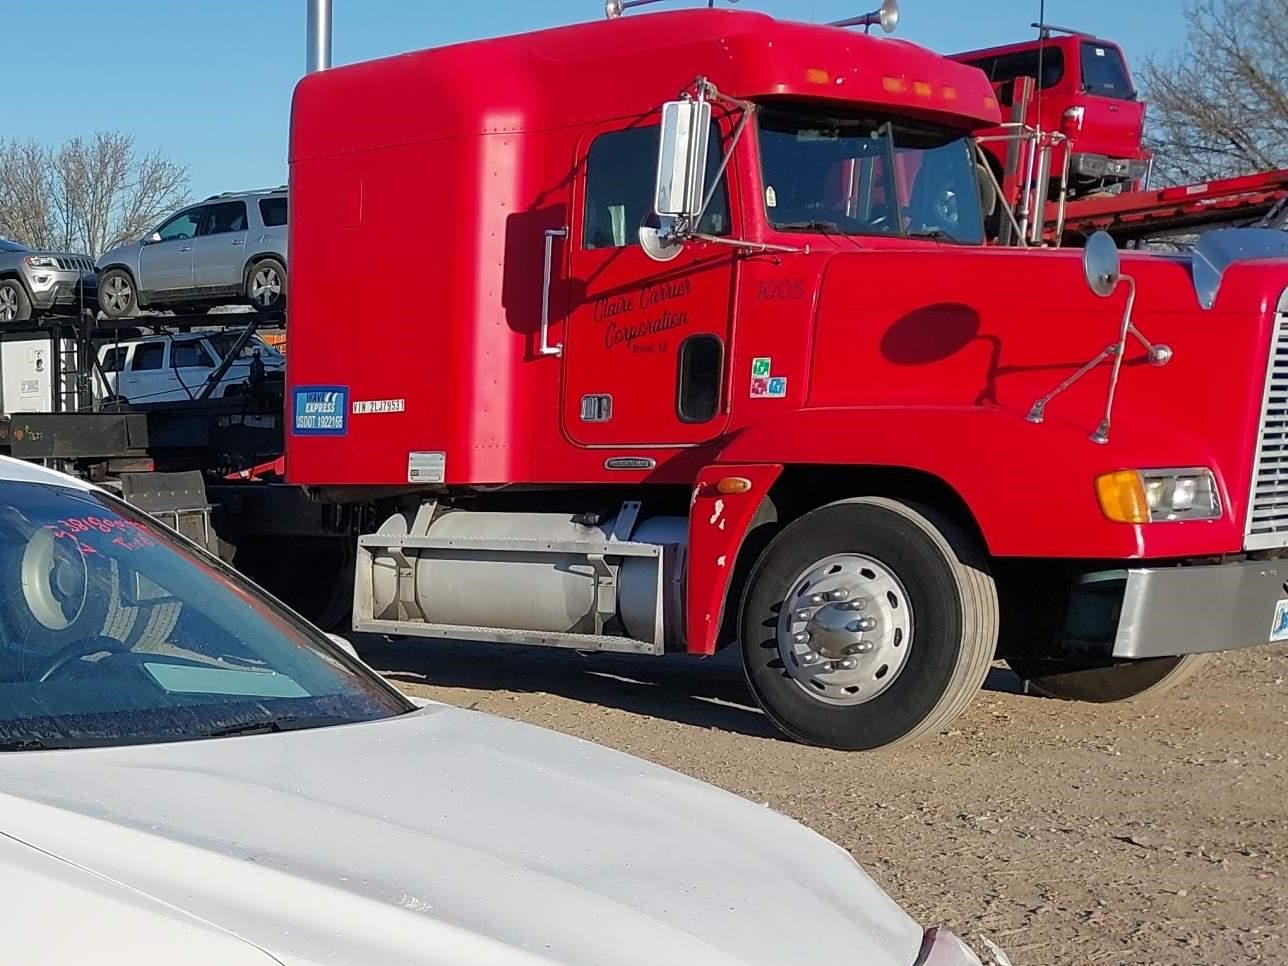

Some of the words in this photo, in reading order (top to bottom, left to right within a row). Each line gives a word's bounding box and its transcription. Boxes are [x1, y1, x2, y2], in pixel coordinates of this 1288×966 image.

[758, 279, 805, 301] 1005
[593, 296, 634, 323] Claire
[639, 278, 692, 310] Carrier
[604, 309, 690, 349] Corporation
[305, 402, 336, 413] EXPRESS
[353, 402, 367, 413] VIN
[295, 415, 316, 429] USDOT
